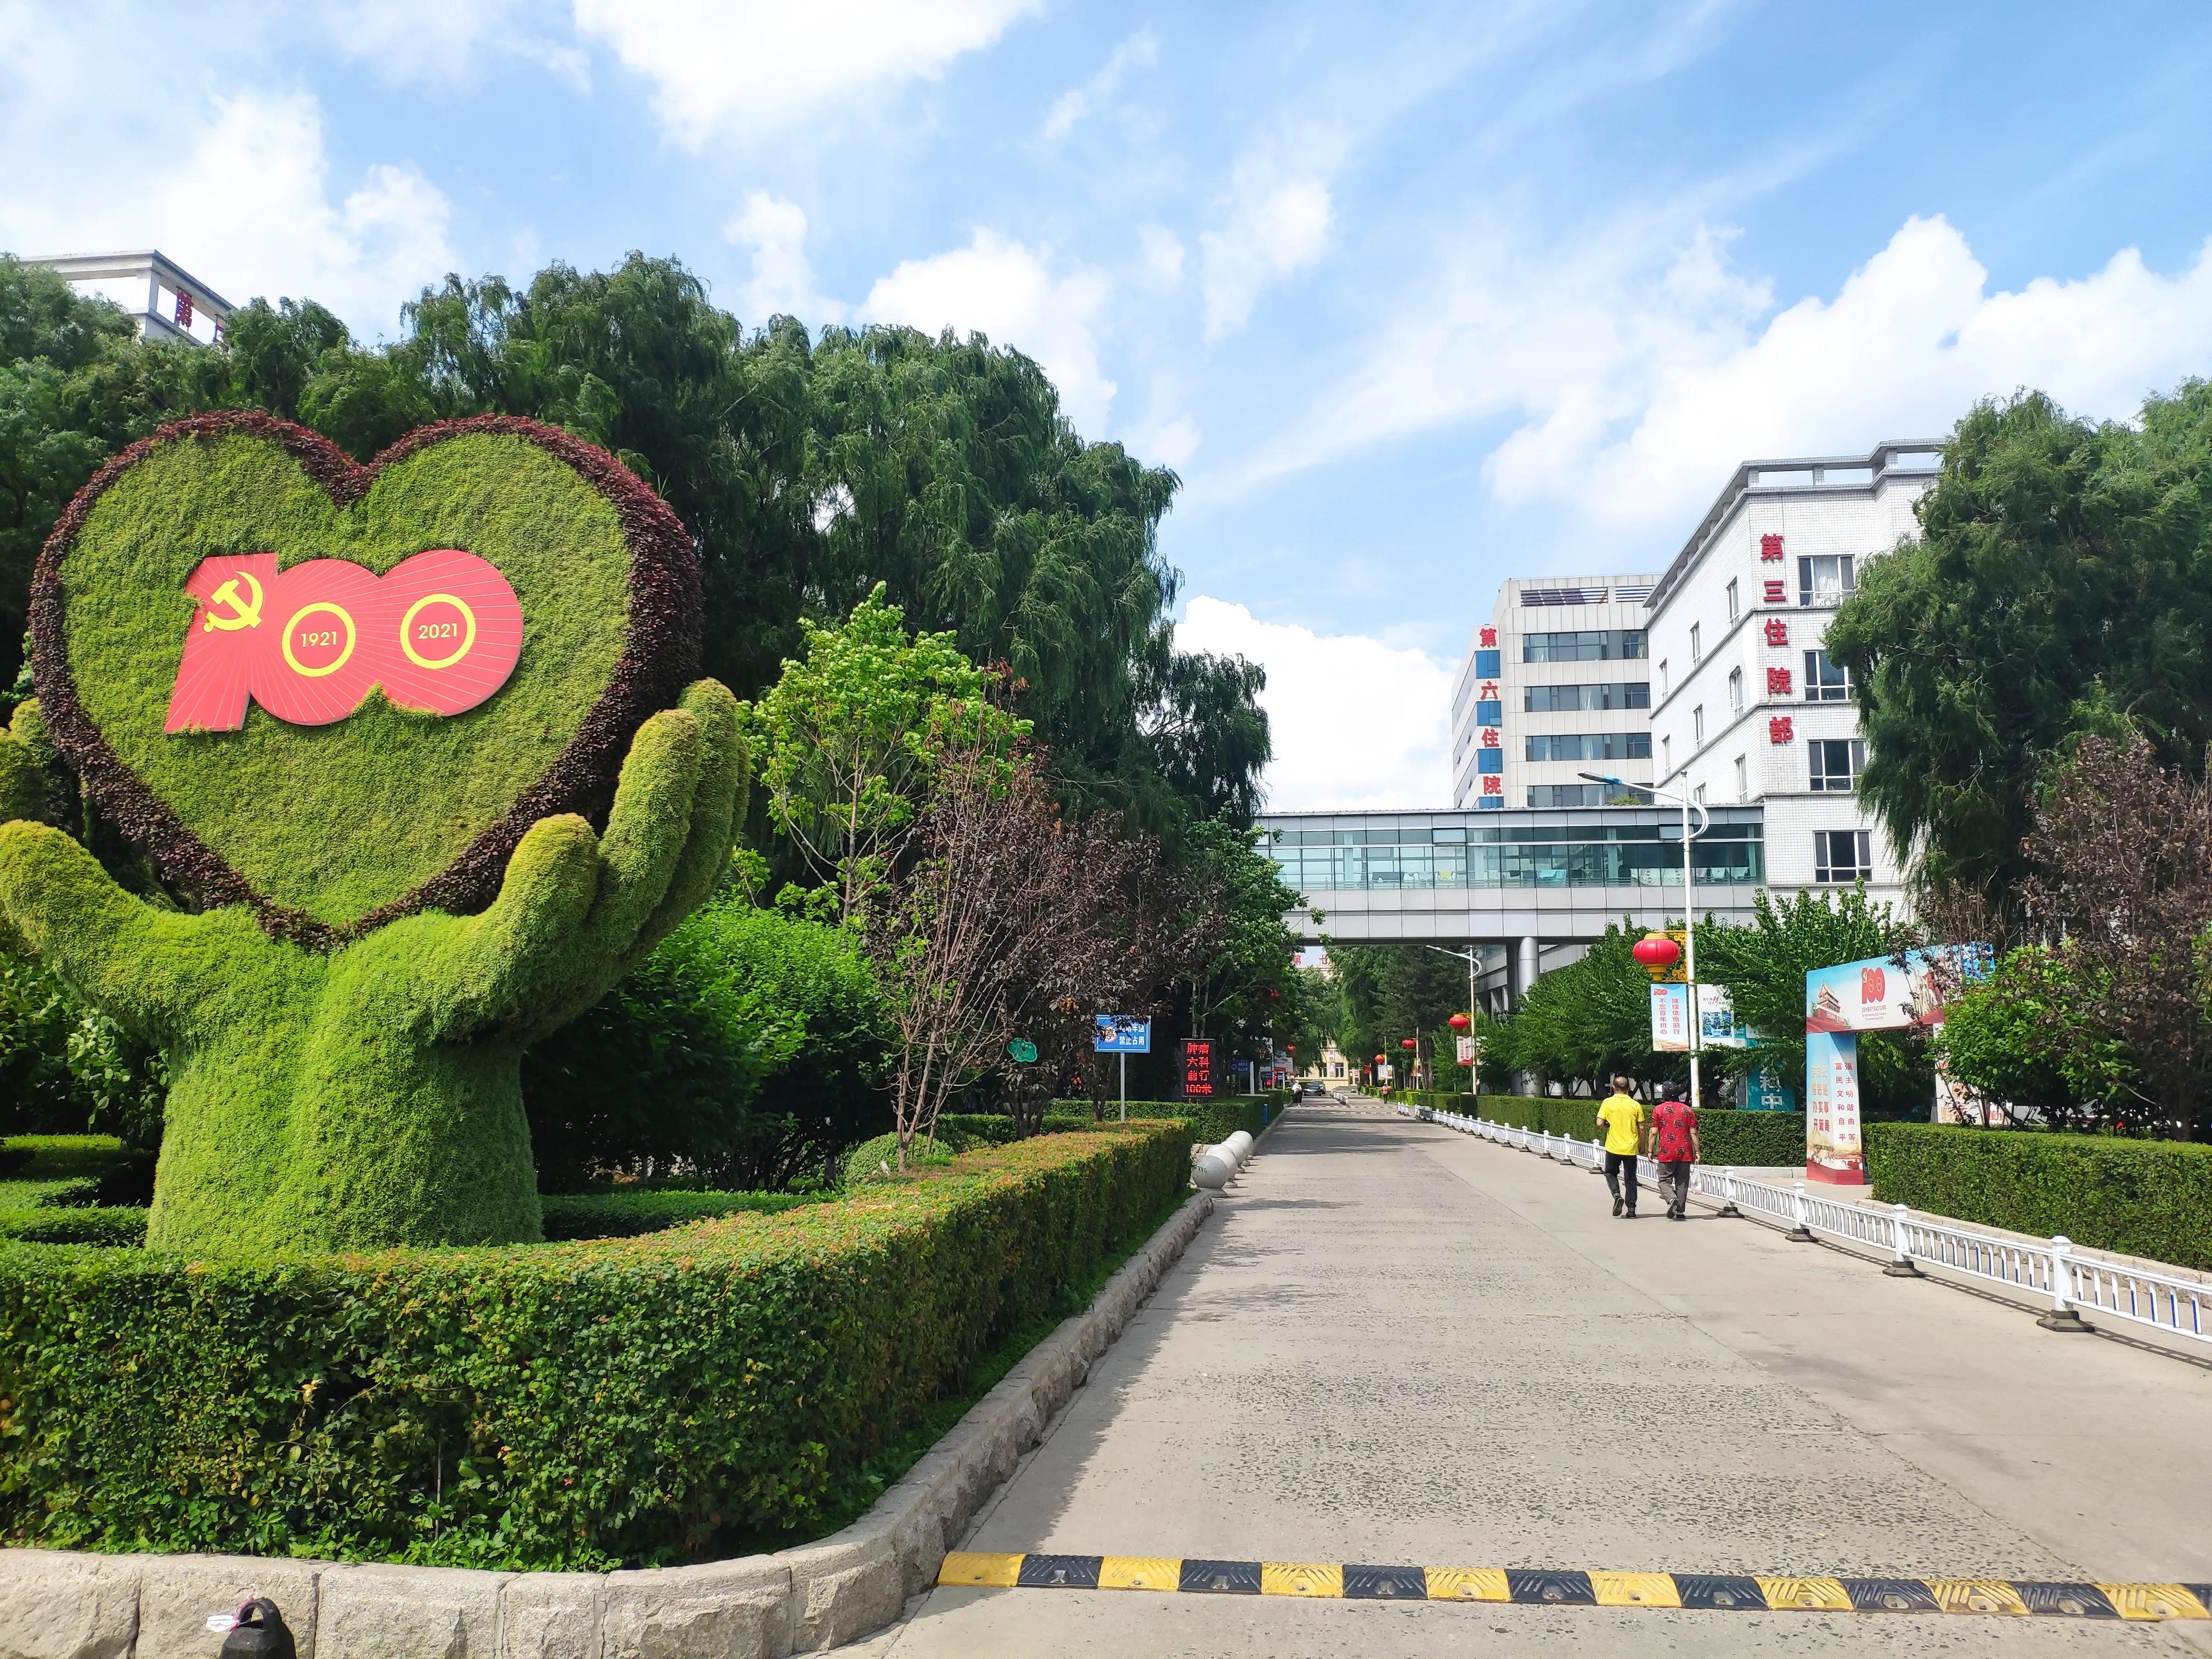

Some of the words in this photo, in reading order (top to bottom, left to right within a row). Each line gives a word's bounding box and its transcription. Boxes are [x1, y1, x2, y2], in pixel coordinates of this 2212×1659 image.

[301, 631, 337, 647] 1921
[418, 623, 457, 639] 2021
[1760, 533, 1793, 744] 第三住院部
[1479, 628, 1502, 795] 第六住院
[1659, 998, 1667, 1035] 不忘百年初心
[1119, 1036, 1144, 1046] 禁止占用
